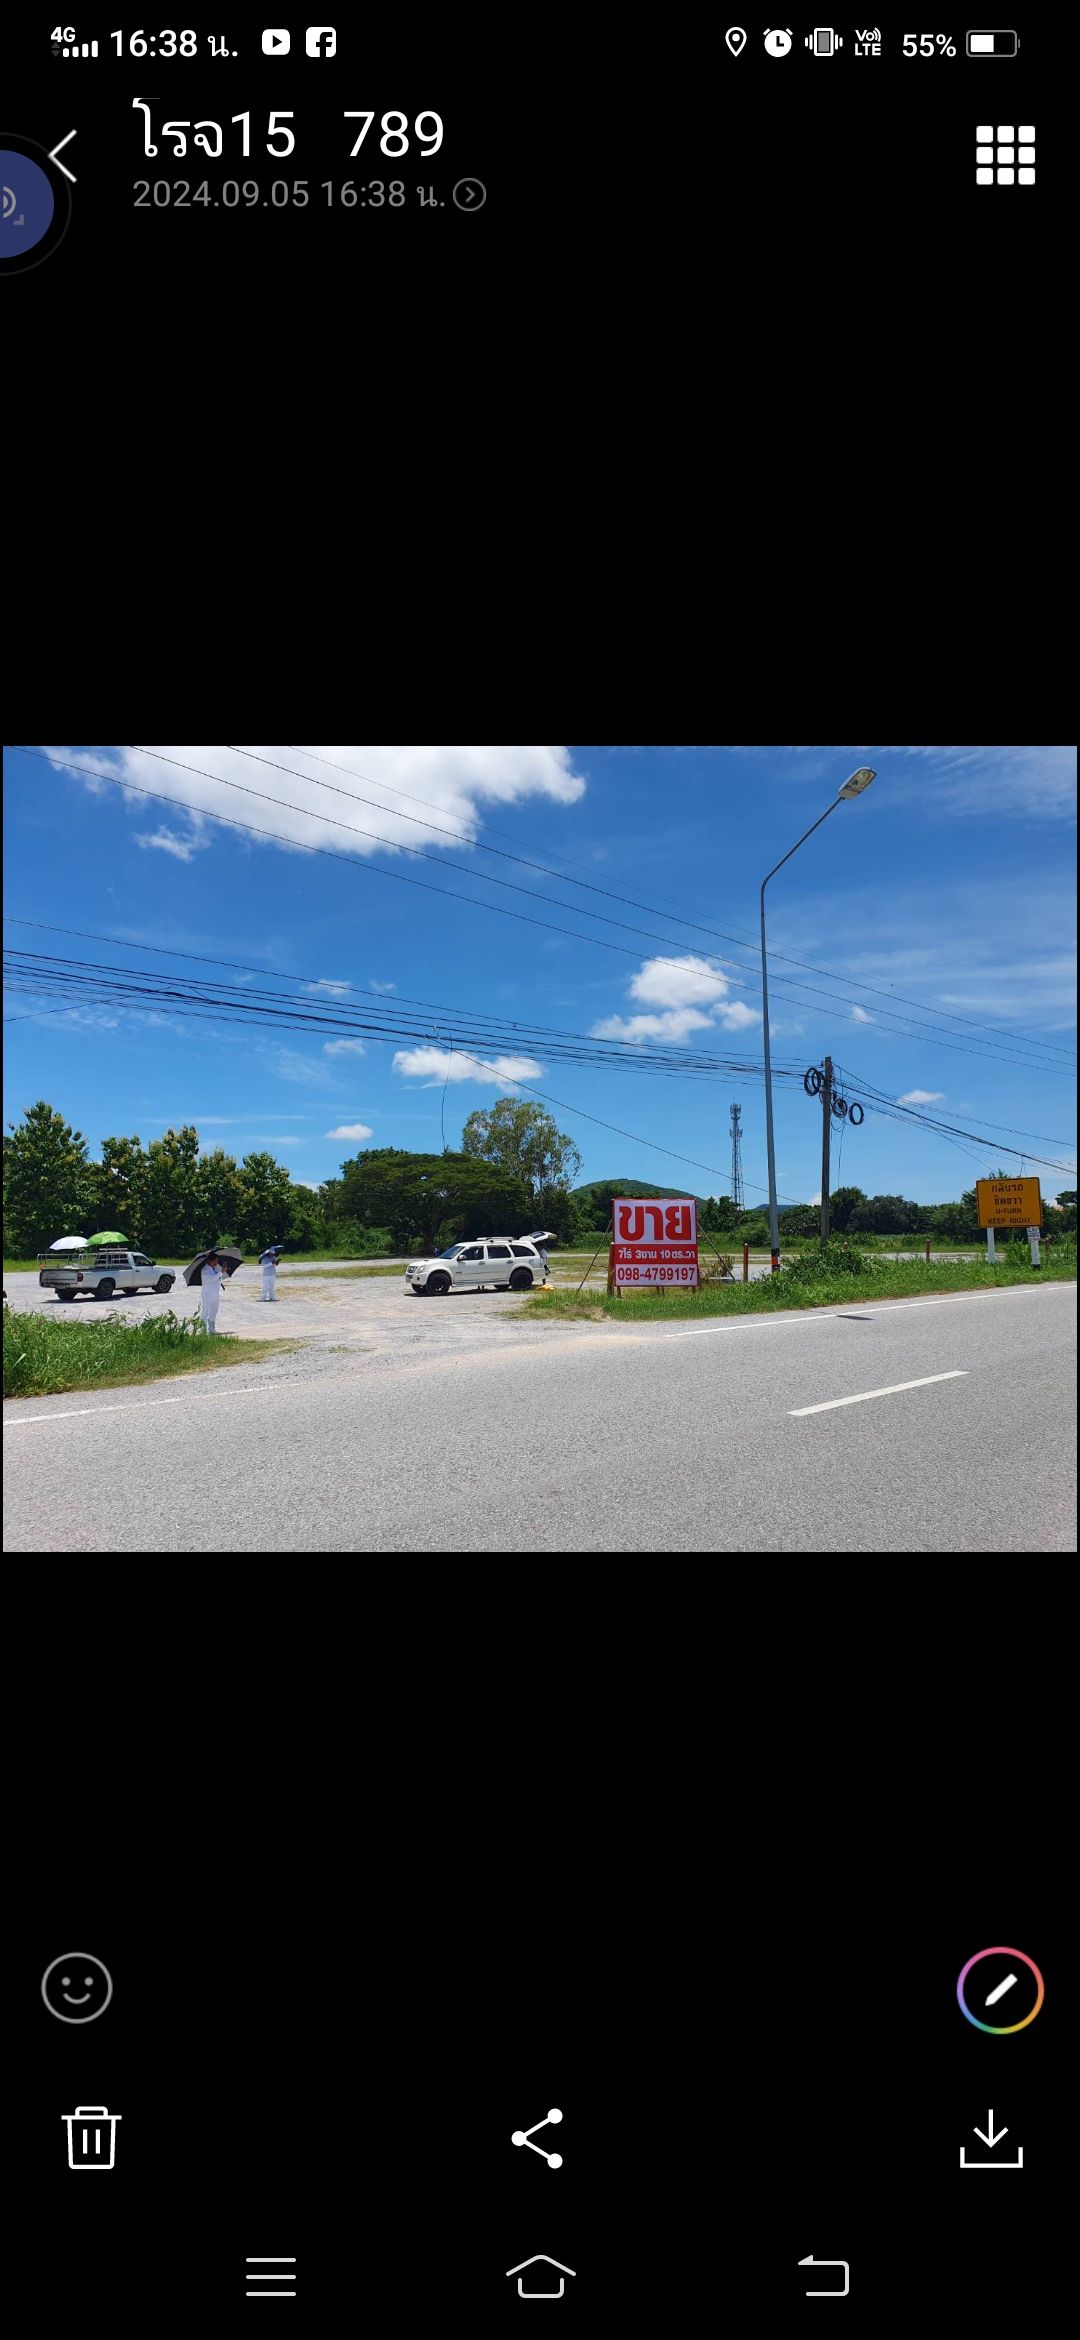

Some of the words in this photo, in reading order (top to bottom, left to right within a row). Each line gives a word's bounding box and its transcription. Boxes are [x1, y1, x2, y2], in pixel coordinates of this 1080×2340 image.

[51, 27, 76, 43] 4G
[110, 30, 198, 57] 16:38
[208, 35, 239, 57] น.
[855, 43, 881, 56] LTE
[902, 34, 957, 57] 55%
[132, 97, 296, 158] โรจ15
[344, 110, 444, 158] 789
[133, 180, 309, 208] 2024.09.05
[321, 180, 406, 207] 16:38
[416, 186, 446, 207] น.
[992, 1182, 1024, 1192] กลับรถ
[618, 1205, 692, 1241] ขาย
[660, 1250, 670, 1259] 10
[617, 1267, 695, 1281] 098-4799197
